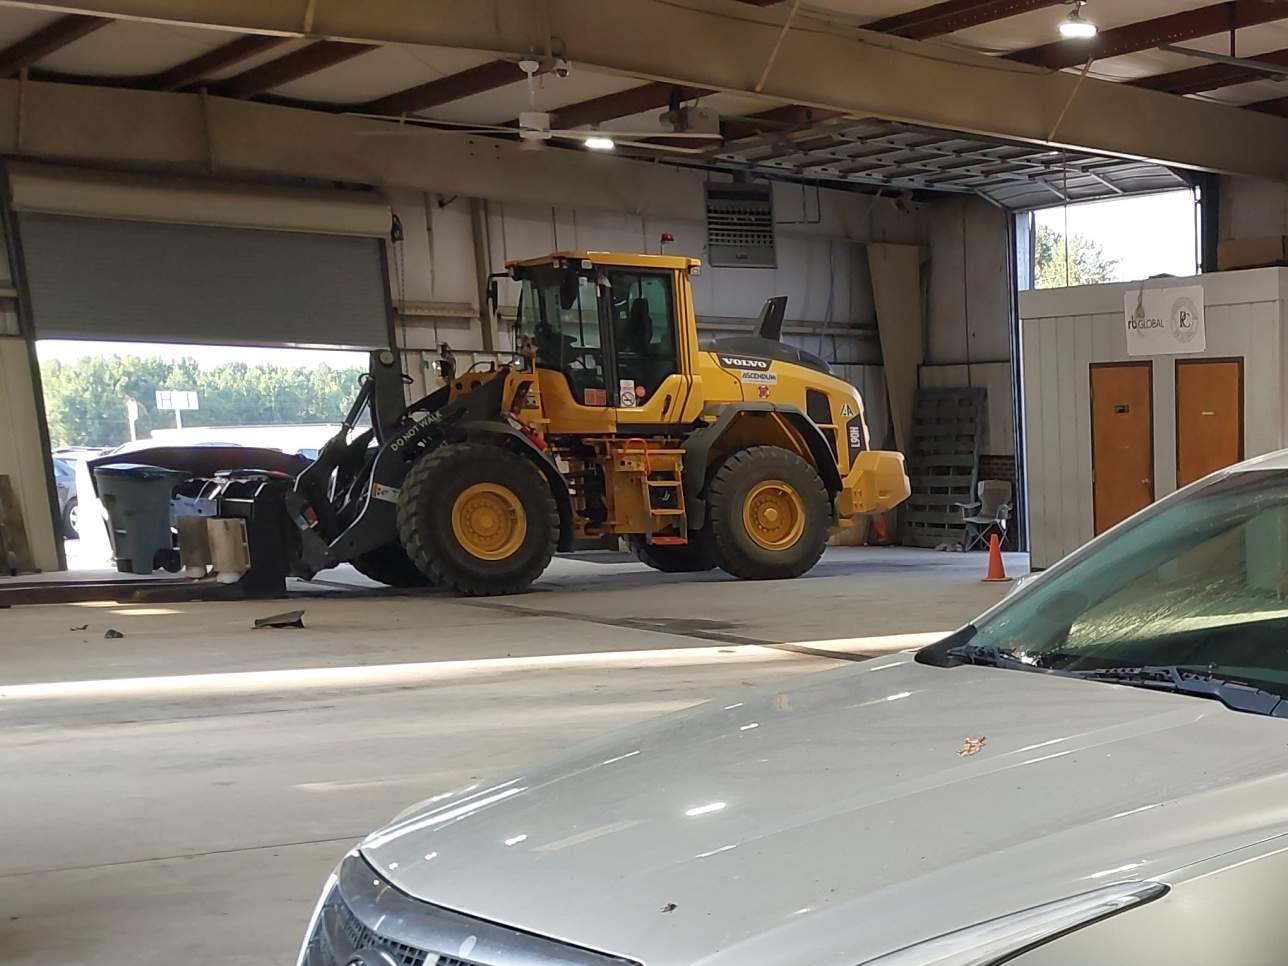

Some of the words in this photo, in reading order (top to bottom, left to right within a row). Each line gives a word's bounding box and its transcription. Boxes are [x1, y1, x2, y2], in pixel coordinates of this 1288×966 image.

[721, 357, 767, 368] VOLVO
[390, 438, 404, 452] DO
[402, 425, 420, 442] NOT
[420, 410, 443, 428] WALK
[849, 426, 860, 448] L90H
